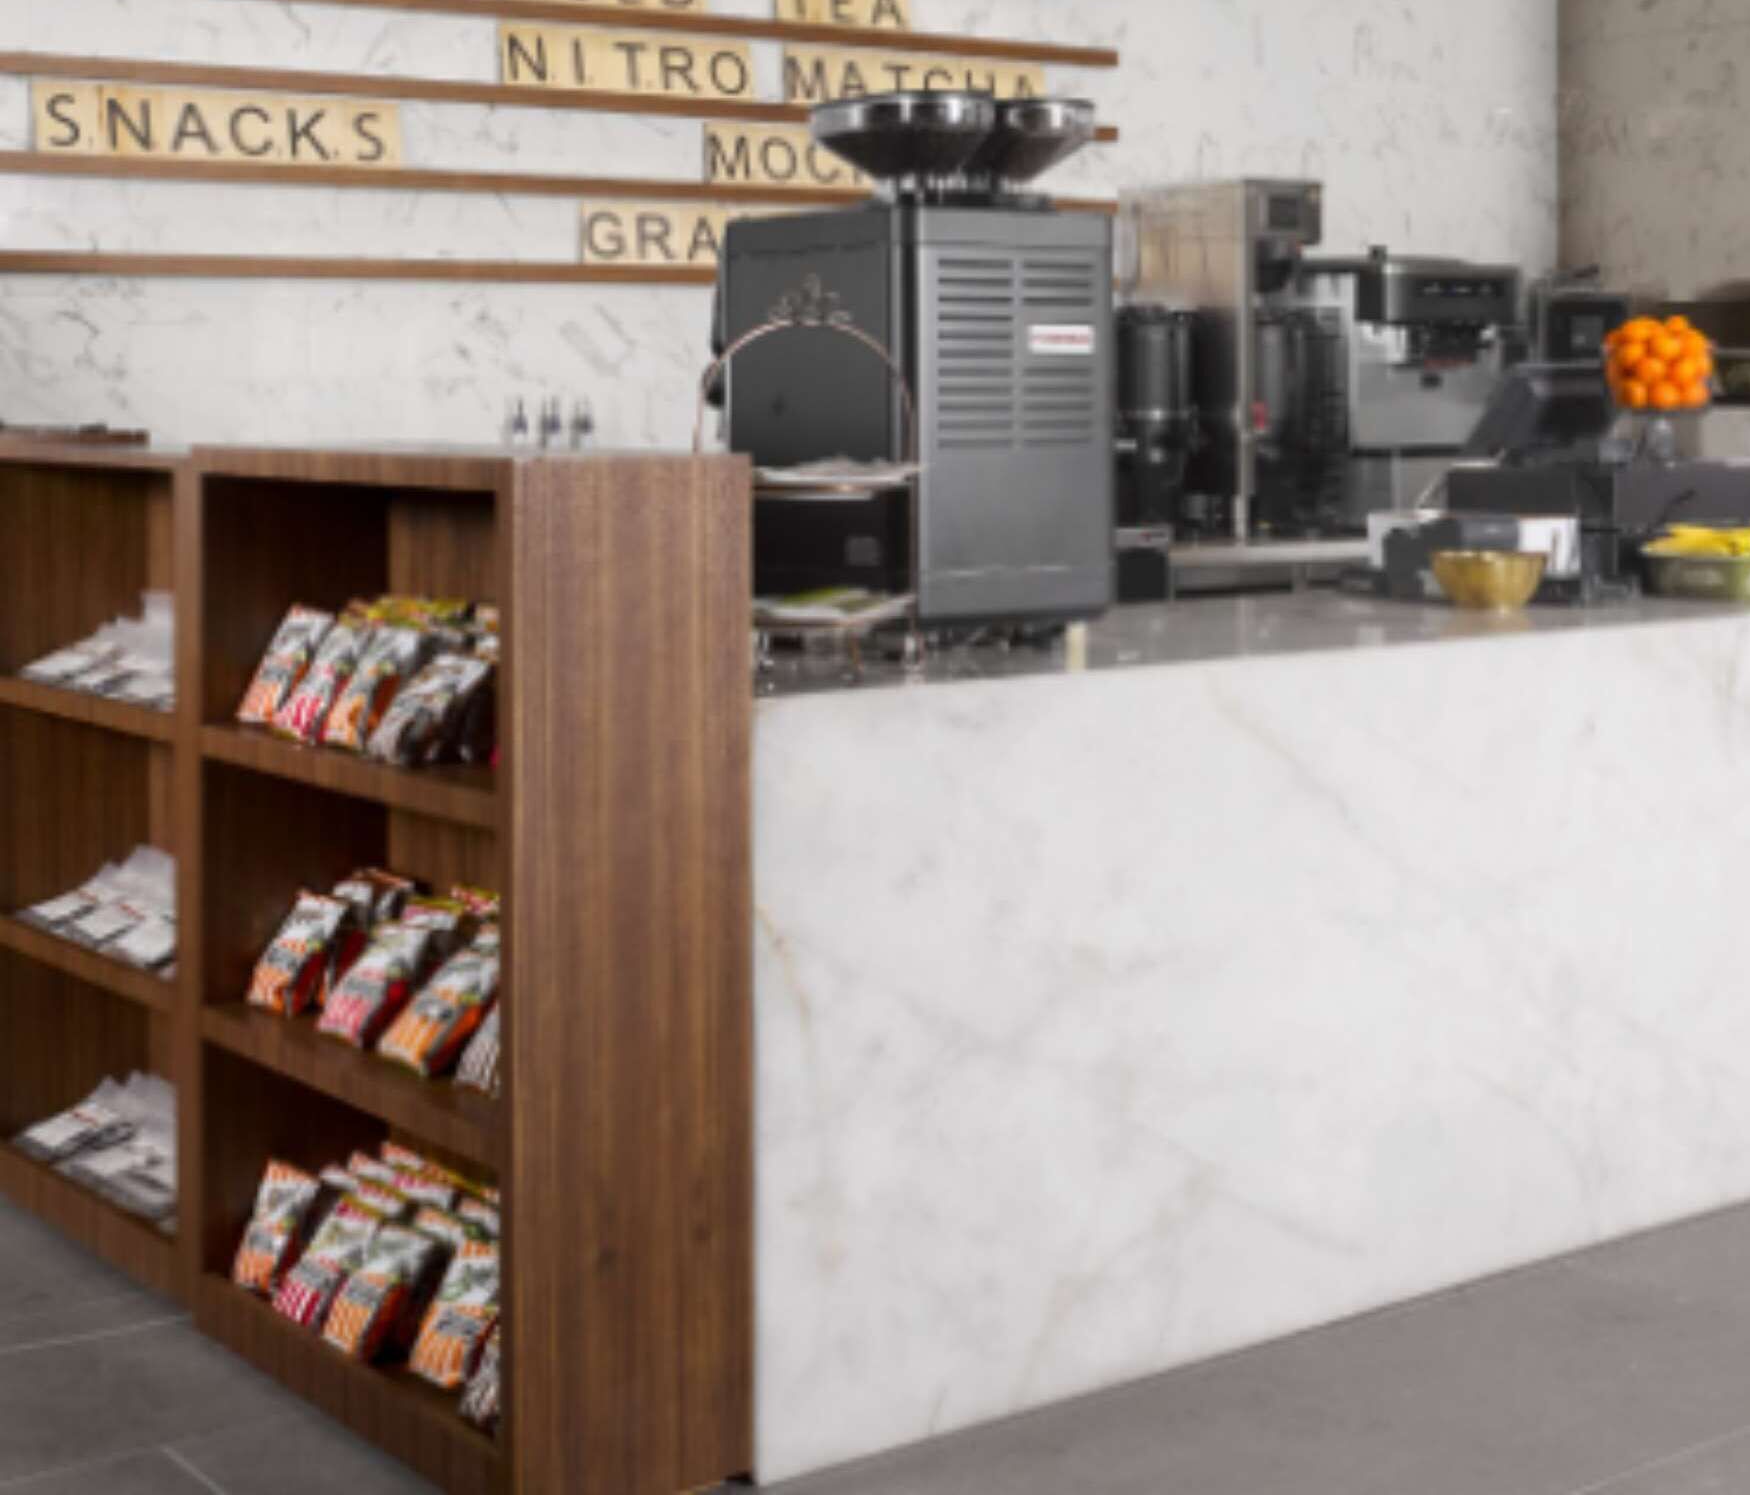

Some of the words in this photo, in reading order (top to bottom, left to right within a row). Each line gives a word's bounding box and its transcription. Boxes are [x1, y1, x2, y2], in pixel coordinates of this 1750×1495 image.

[508, 33, 748, 95] NITRO
[45, 93, 386, 162] SNACKS
[704, 134, 863, 183] MOC
